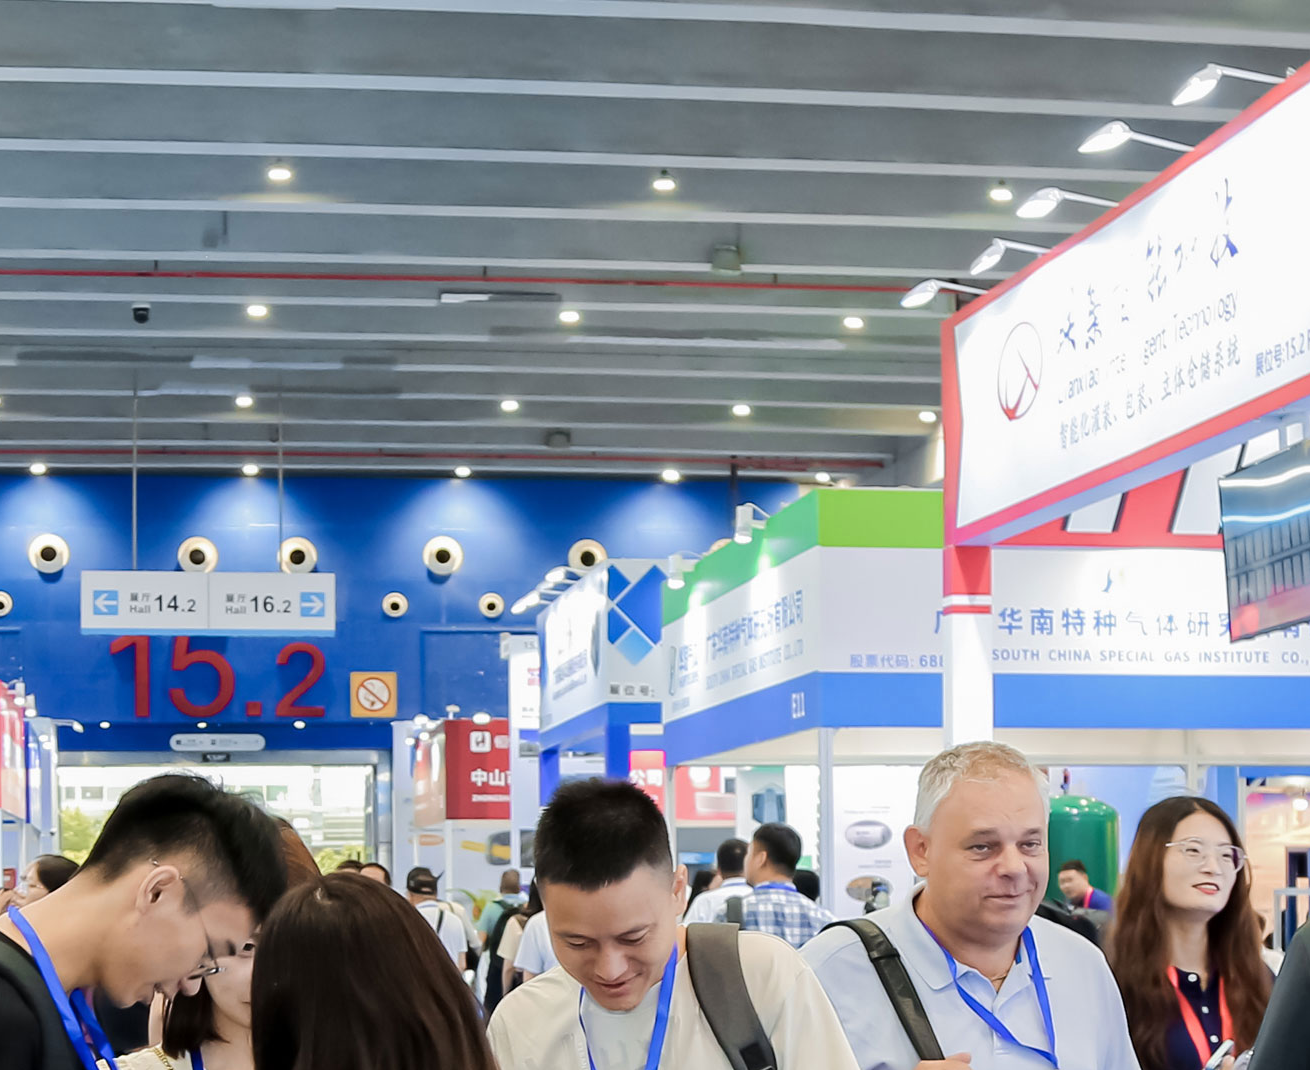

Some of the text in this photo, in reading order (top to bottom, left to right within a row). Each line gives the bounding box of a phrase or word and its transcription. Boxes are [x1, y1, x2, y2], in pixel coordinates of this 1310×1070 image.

[130, 592, 151, 602] 展厅
[154, 594, 197, 613] 14.2
[225, 593, 246, 603] 展厅
[250, 595, 292, 614] 16.2
[130, 604, 151, 614] Hall
[225, 605, 247, 615] Hall
[992, 648, 1040, 661] SOUTH
[1049, 649, 1092, 662] CHINA
[1100, 651, 1154, 662] SPECIAL
[1164, 652, 1190, 663] GAS
[1198, 652, 1270, 664] INSTITUTE
[109, 635, 326, 718] 15.2
[791, 691, 806, 719] E11
[470, 768, 511, 787] 中山
